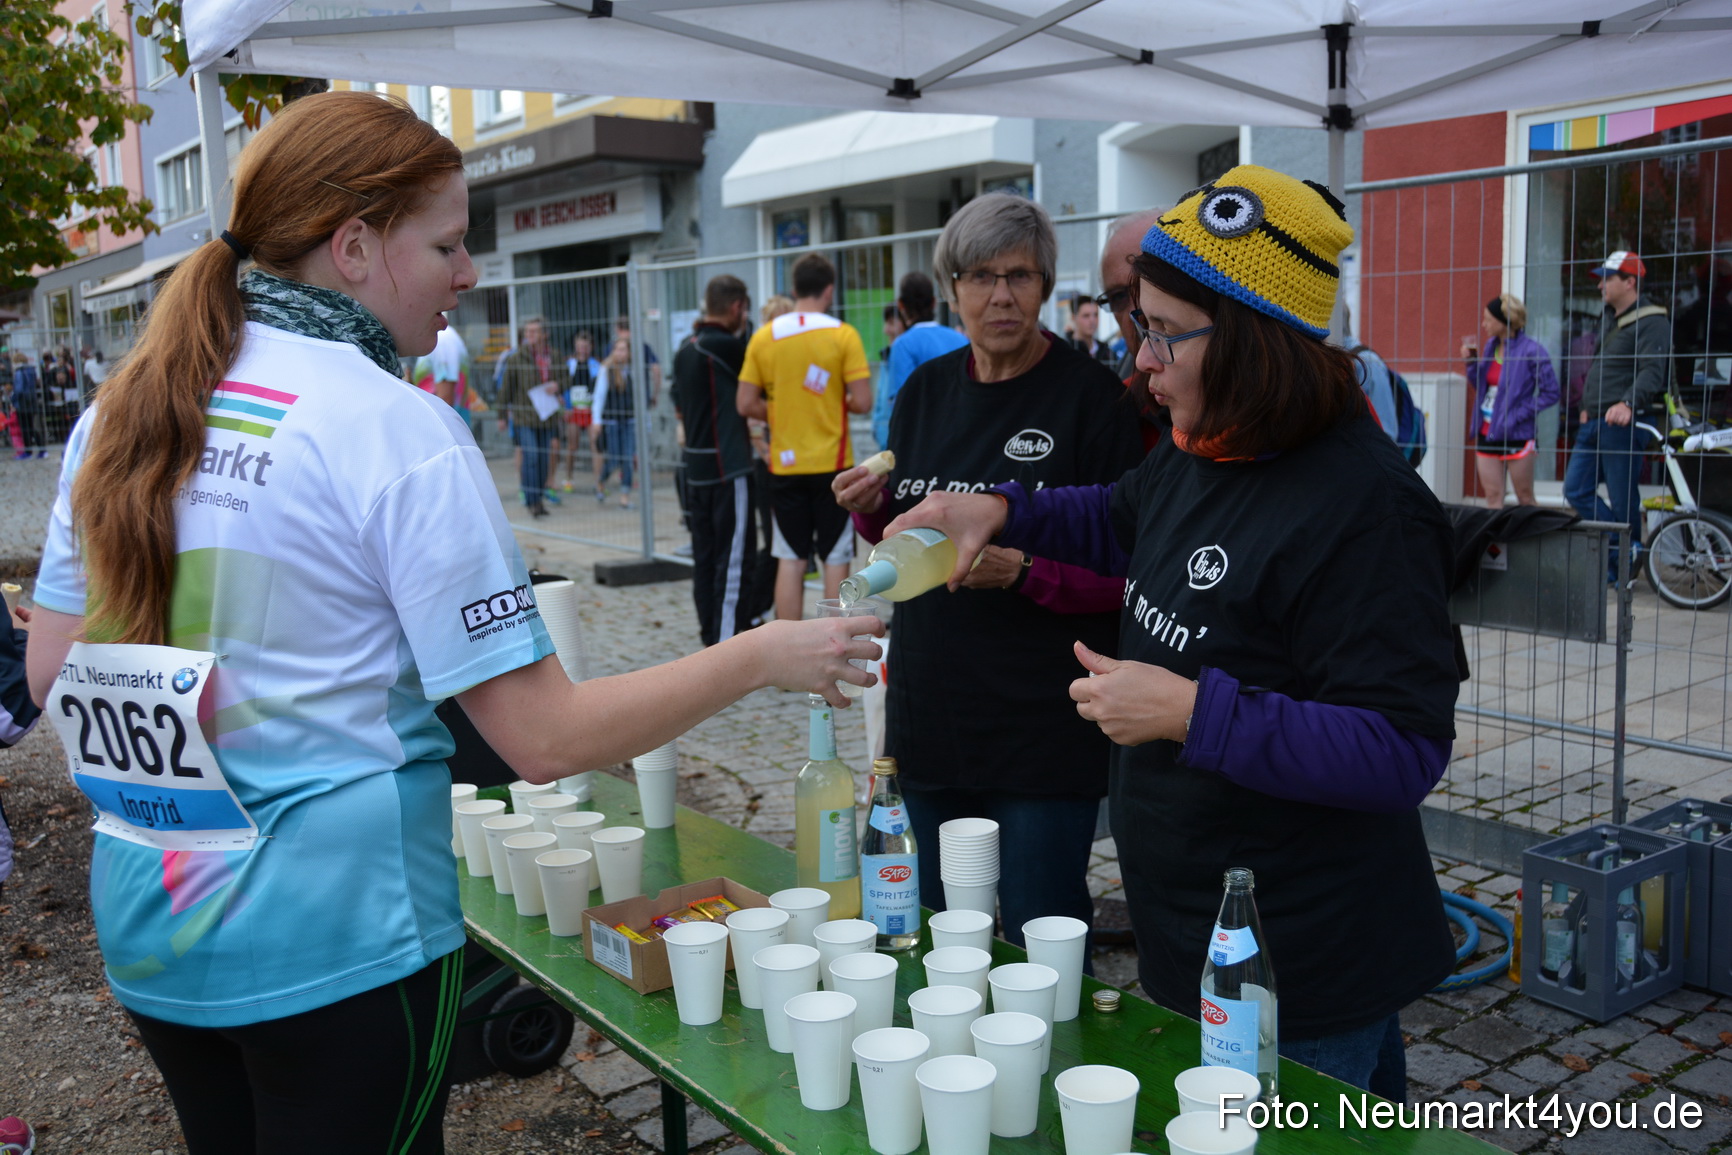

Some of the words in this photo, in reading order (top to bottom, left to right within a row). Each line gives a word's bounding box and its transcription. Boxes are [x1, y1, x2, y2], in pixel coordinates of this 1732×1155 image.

[514, 207, 537, 231] KINO
[541, 191, 617, 227] GESCHLOSSEN
[1008, 436, 1049, 454] Hervis
[198, 442, 273, 487] arkt
[895, 476, 938, 499] get
[190, 490, 249, 513] genießen
[469, 622, 503, 643] inspired
[505, 620, 516, 629] by
[59, 662, 86, 683] RTL
[86, 665, 163, 690] Neumarkt
[61, 694, 204, 778] 2062
[118, 791, 184, 827] Ingrid
[878, 867, 911, 881] SAPS
[869, 888, 918, 900] SPRITZIG
[1202, 1029, 1241, 1052] RITZIG
